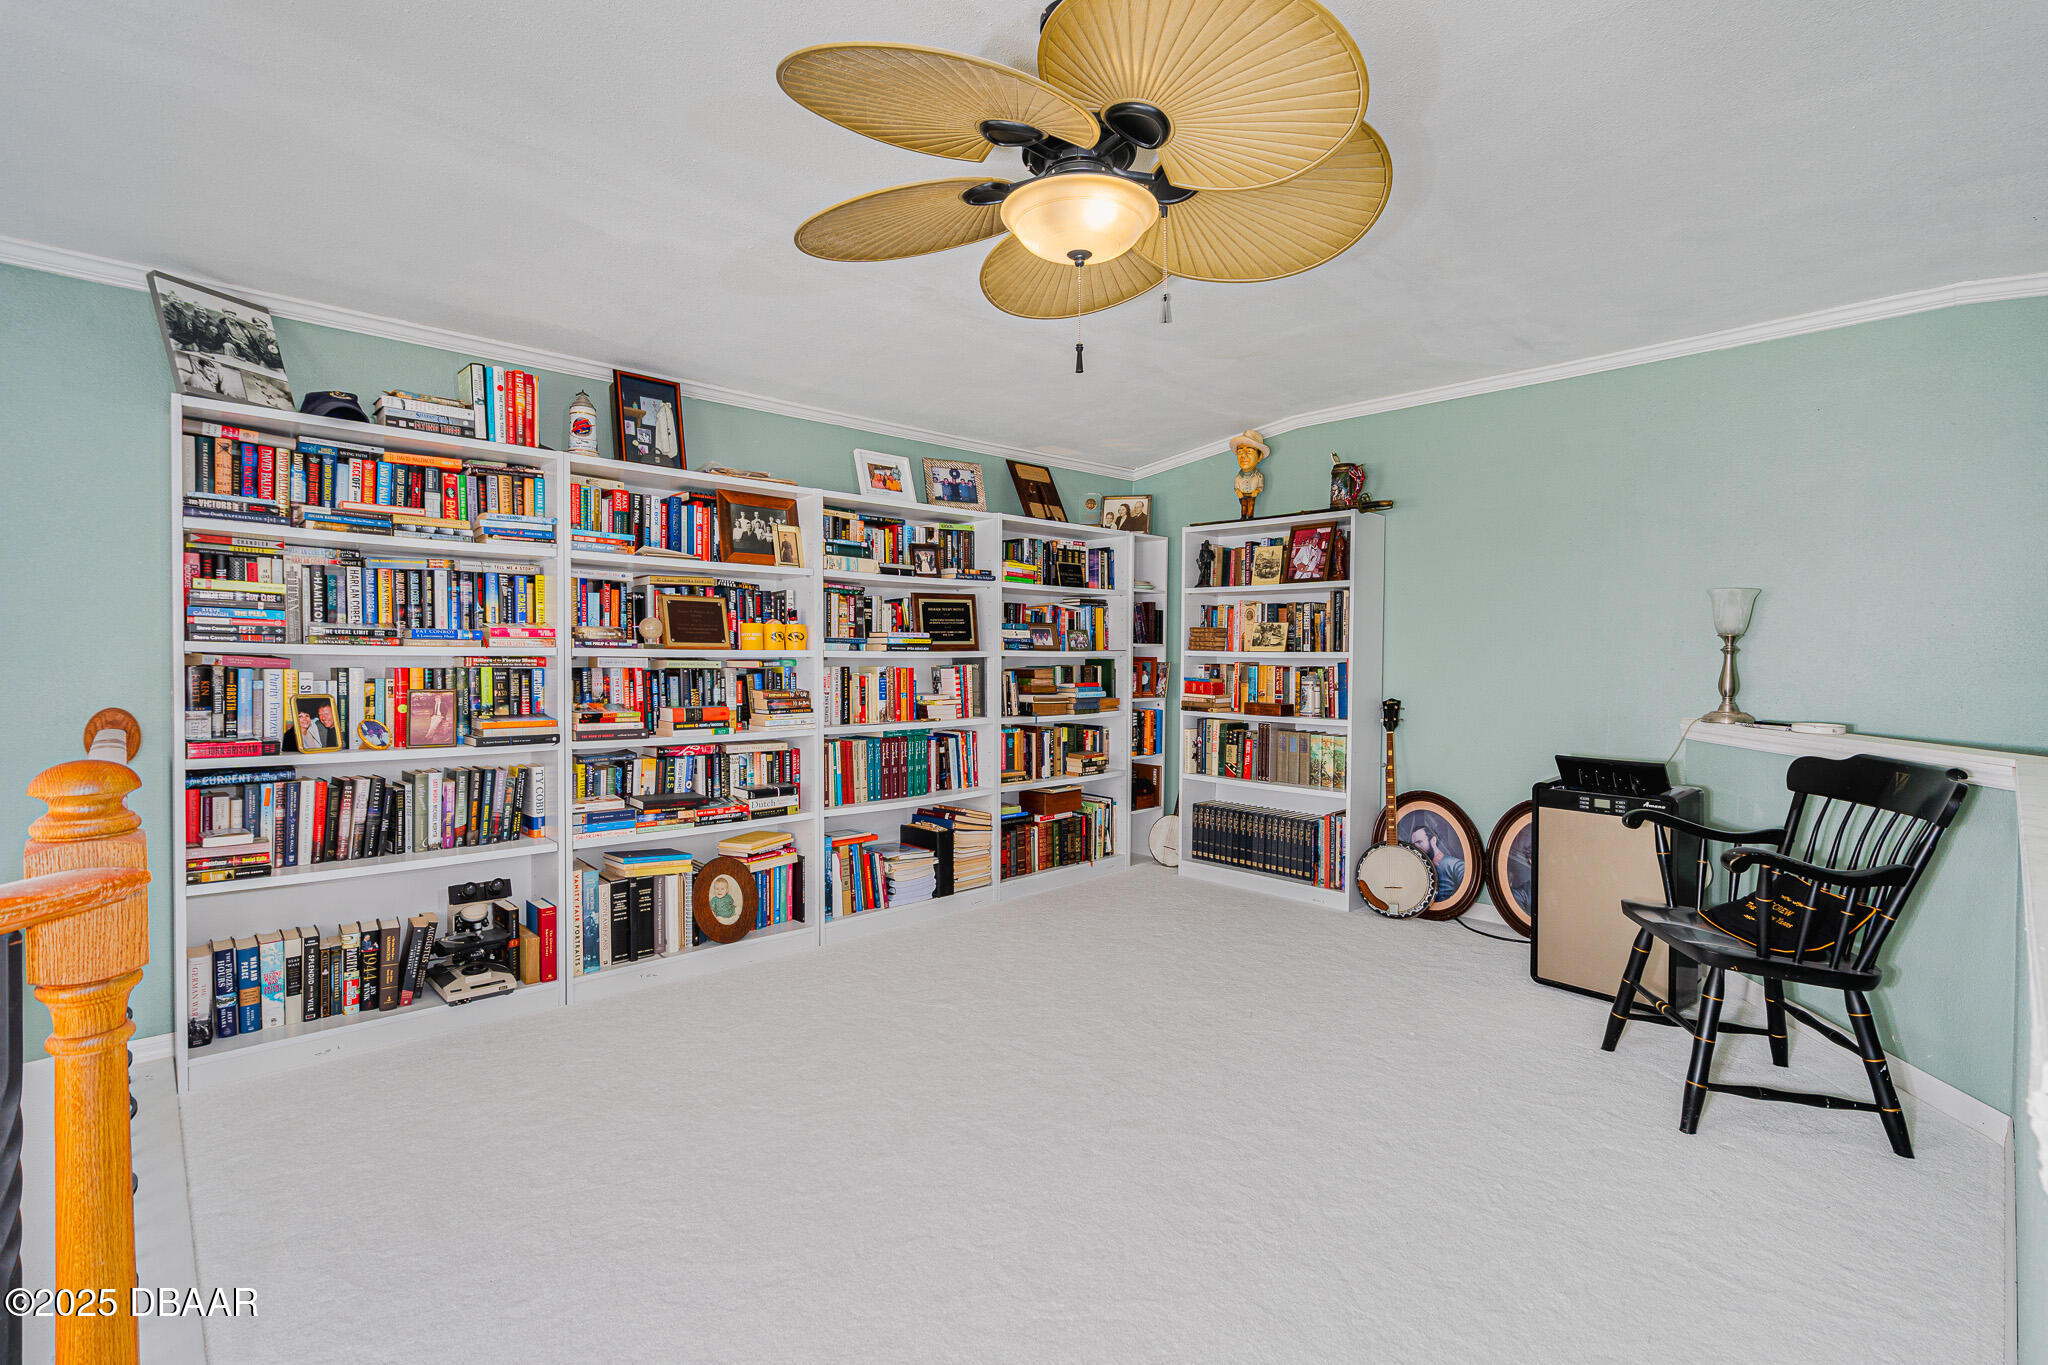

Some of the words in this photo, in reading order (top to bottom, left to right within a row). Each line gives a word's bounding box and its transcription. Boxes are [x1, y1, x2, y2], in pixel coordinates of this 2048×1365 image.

[516, 373, 524, 402] TOPGUN
[260, 448, 273, 471] DAVID
[278, 450, 289, 471] DAVID
[294, 453, 304, 471] DAVID
[309, 463, 320, 481] DAVID
[324, 464, 333, 479] DAVID
[351, 461, 361, 489] FACEOFF
[379, 464, 389, 483] DAVID
[397, 468, 406, 484] DAVID
[324, 480, 333, 501] BALDACCI
[199, 499, 232, 510] VICTORS
[614, 492, 622, 510] BOOT
[621, 494, 629, 509] MAX
[237, 538, 269, 547] CHANDLER
[349, 569, 361, 598] HARLAN
[365, 569, 375, 592] HARLAN
[382, 570, 391, 592] HARLAN
[396, 572, 405, 589] HARLAN
[411, 572, 419, 590] HARLAN
[365, 593, 375, 614] COBEN
[395, 590, 405, 605] COBEN
[411, 590, 419, 605] COBEN
[517, 593, 527, 612] CRAIS
[233, 610, 248, 618] THE
[201, 681, 210, 697] KEN
[269, 673, 280, 698] Purity
[226, 684, 237, 711] FORSYTH
[226, 720, 237, 733] THE
[269, 702, 280, 740] Franzen
[208, 746, 226, 755] JOHN
[227, 744, 259, 754] GRISHAM
[202, 774, 252, 786] CURRENT
[535, 770, 544, 784] TY
[667, 766, 675, 789] LIES
[535, 786, 544, 815] COBB
[751, 801, 776, 809] Dutch
[421, 925, 435, 964] AUGUSTUS
[346, 948, 358, 972] PACIFIC
[363, 953, 377, 981] 1944
[217, 960, 225, 988] HOURS
[225, 963, 234, 993] FROZEN
[241, 962, 249, 980] PEACE
[250, 969, 258, 982] AND
[191, 967, 201, 1000] GERMAN
[191, 1001, 201, 1017] WAR
